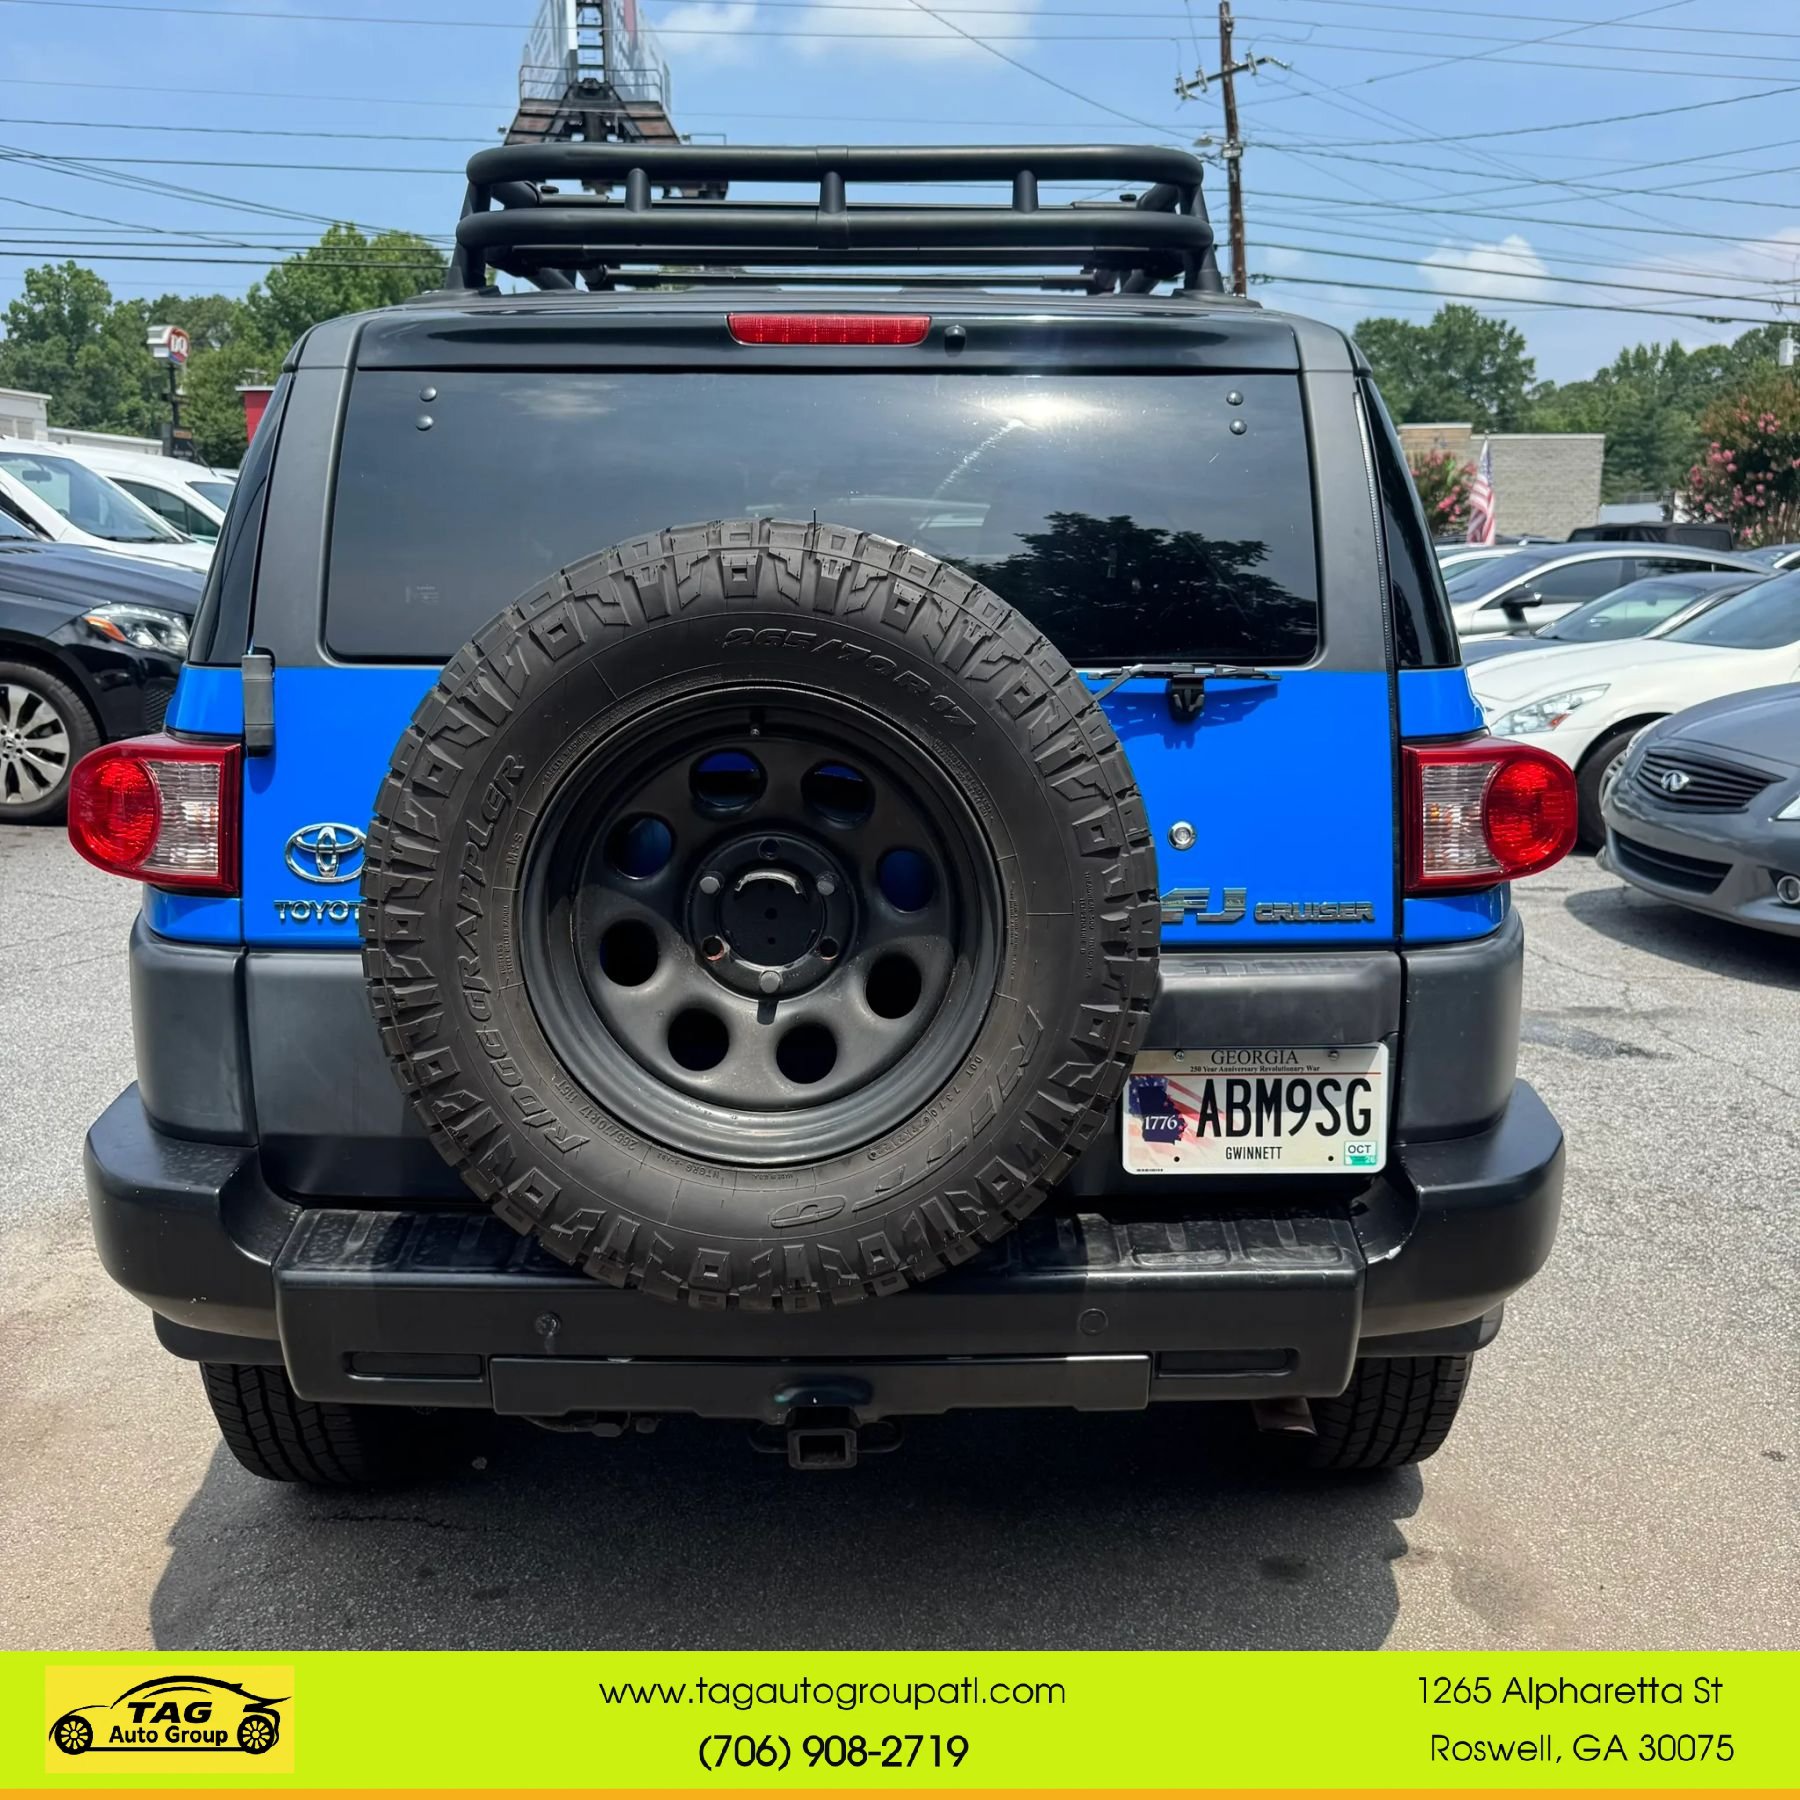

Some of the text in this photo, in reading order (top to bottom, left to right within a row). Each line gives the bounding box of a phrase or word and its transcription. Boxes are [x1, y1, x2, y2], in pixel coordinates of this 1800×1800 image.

[170, 334, 188, 357] DQ
[273, 899, 362, 921] TOYOT
[1160, 887, 1376, 923] FJ CRUISER
[454, 753, 591, 1154] RIDGE GRAPPLER
[1211, 1049, 1299, 1065] GEORGIA
[1190, 1065, 1320, 1074] 250 Year Anniversary Revolutionary War
[1196, 1078, 1373, 1138] ABM9SG
[1144, 1114, 1178, 1131] 1776
[1225, 1146, 1283, 1160] GWINNETT
[1348, 1144, 1371, 1154] OCT
